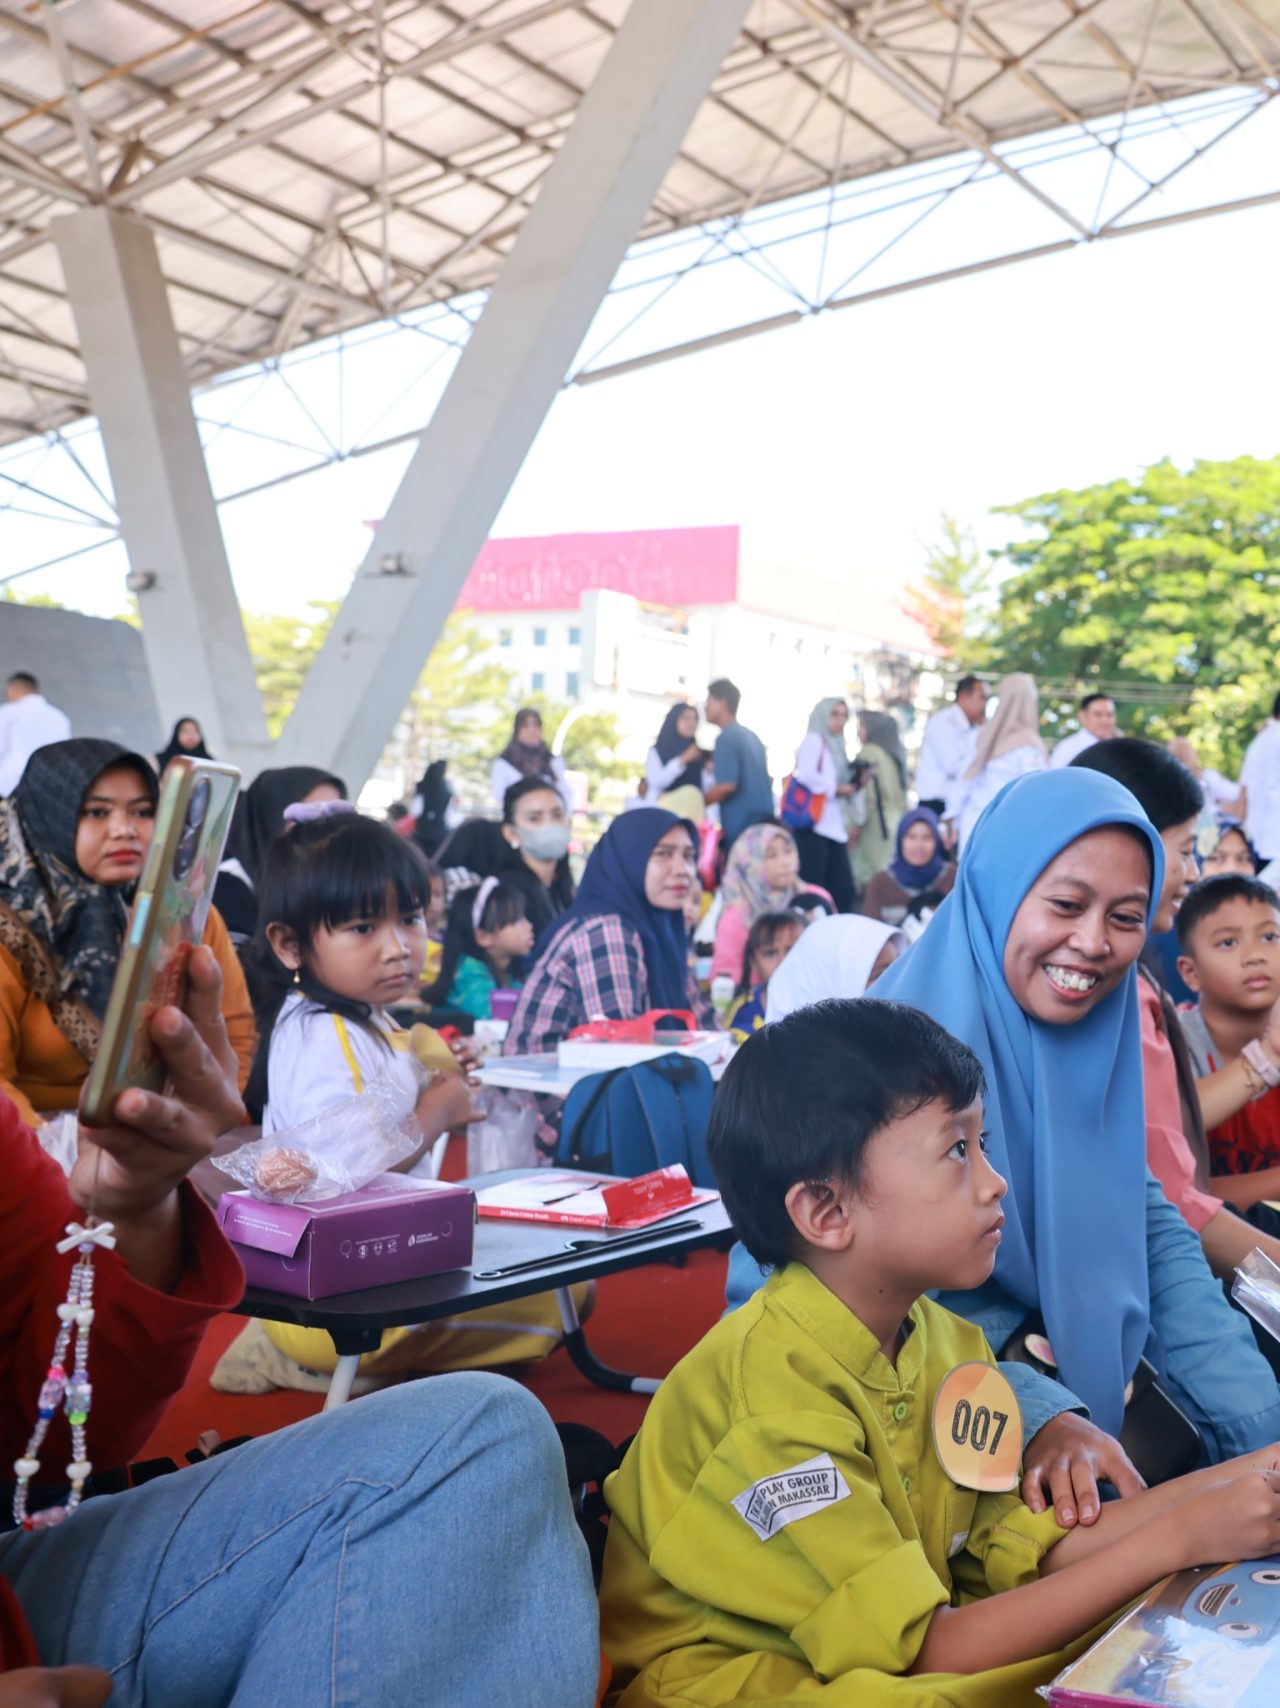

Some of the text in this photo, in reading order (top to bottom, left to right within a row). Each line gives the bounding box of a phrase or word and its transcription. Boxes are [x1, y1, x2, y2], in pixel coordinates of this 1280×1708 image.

[952, 1399, 1008, 1456] 007
[759, 1481, 785, 1500] PLAY
[787, 1473, 829, 1490] GROUP
[777, 1484, 830, 1505] MAKASSAR
